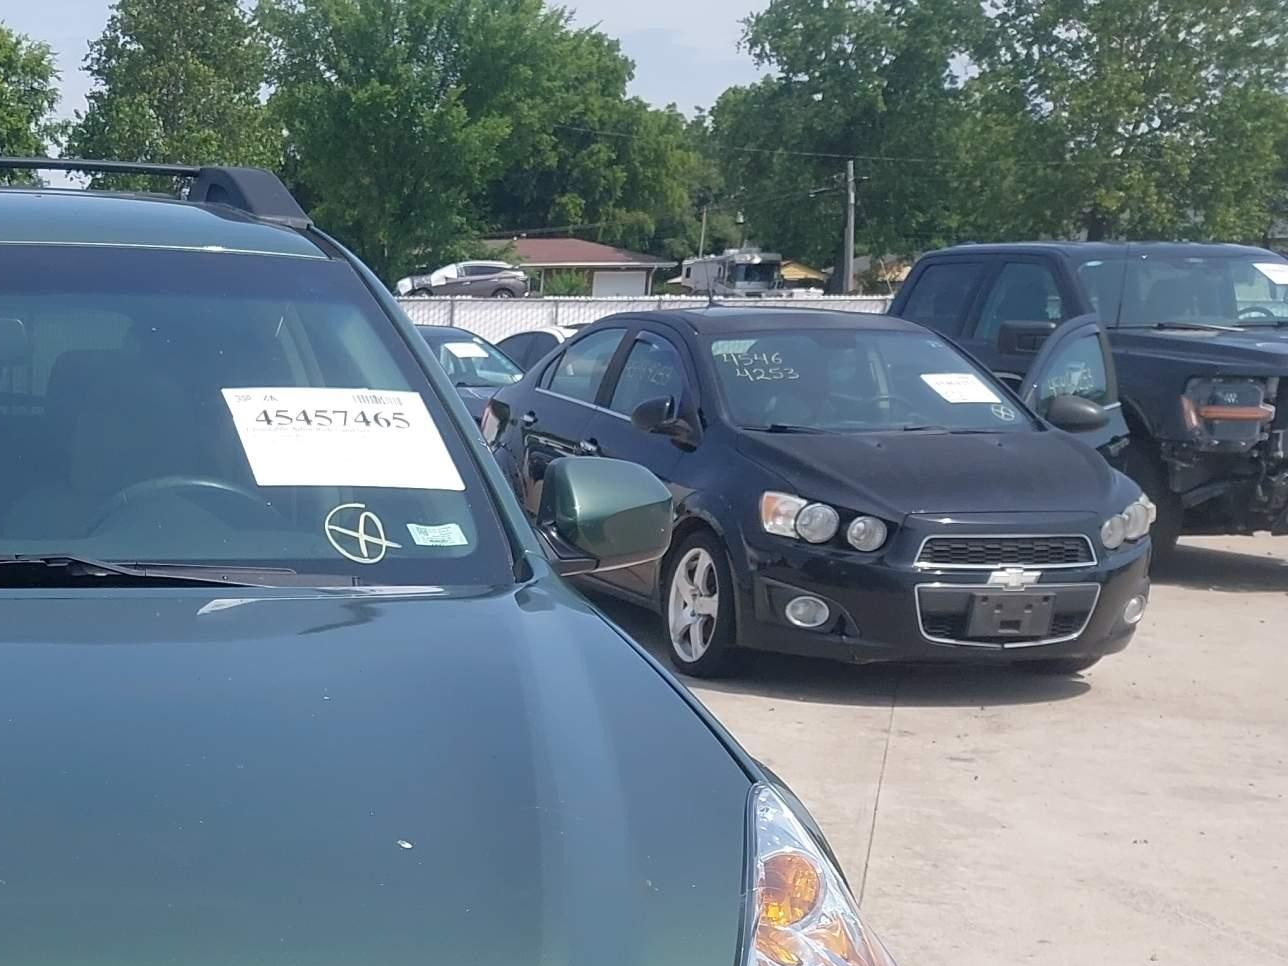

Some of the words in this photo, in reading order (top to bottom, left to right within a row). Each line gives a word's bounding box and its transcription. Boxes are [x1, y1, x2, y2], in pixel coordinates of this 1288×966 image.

[722, 352, 782, 366] 4546
[736, 368, 799, 381] 4253
[255, 409, 411, 429] 45457465
